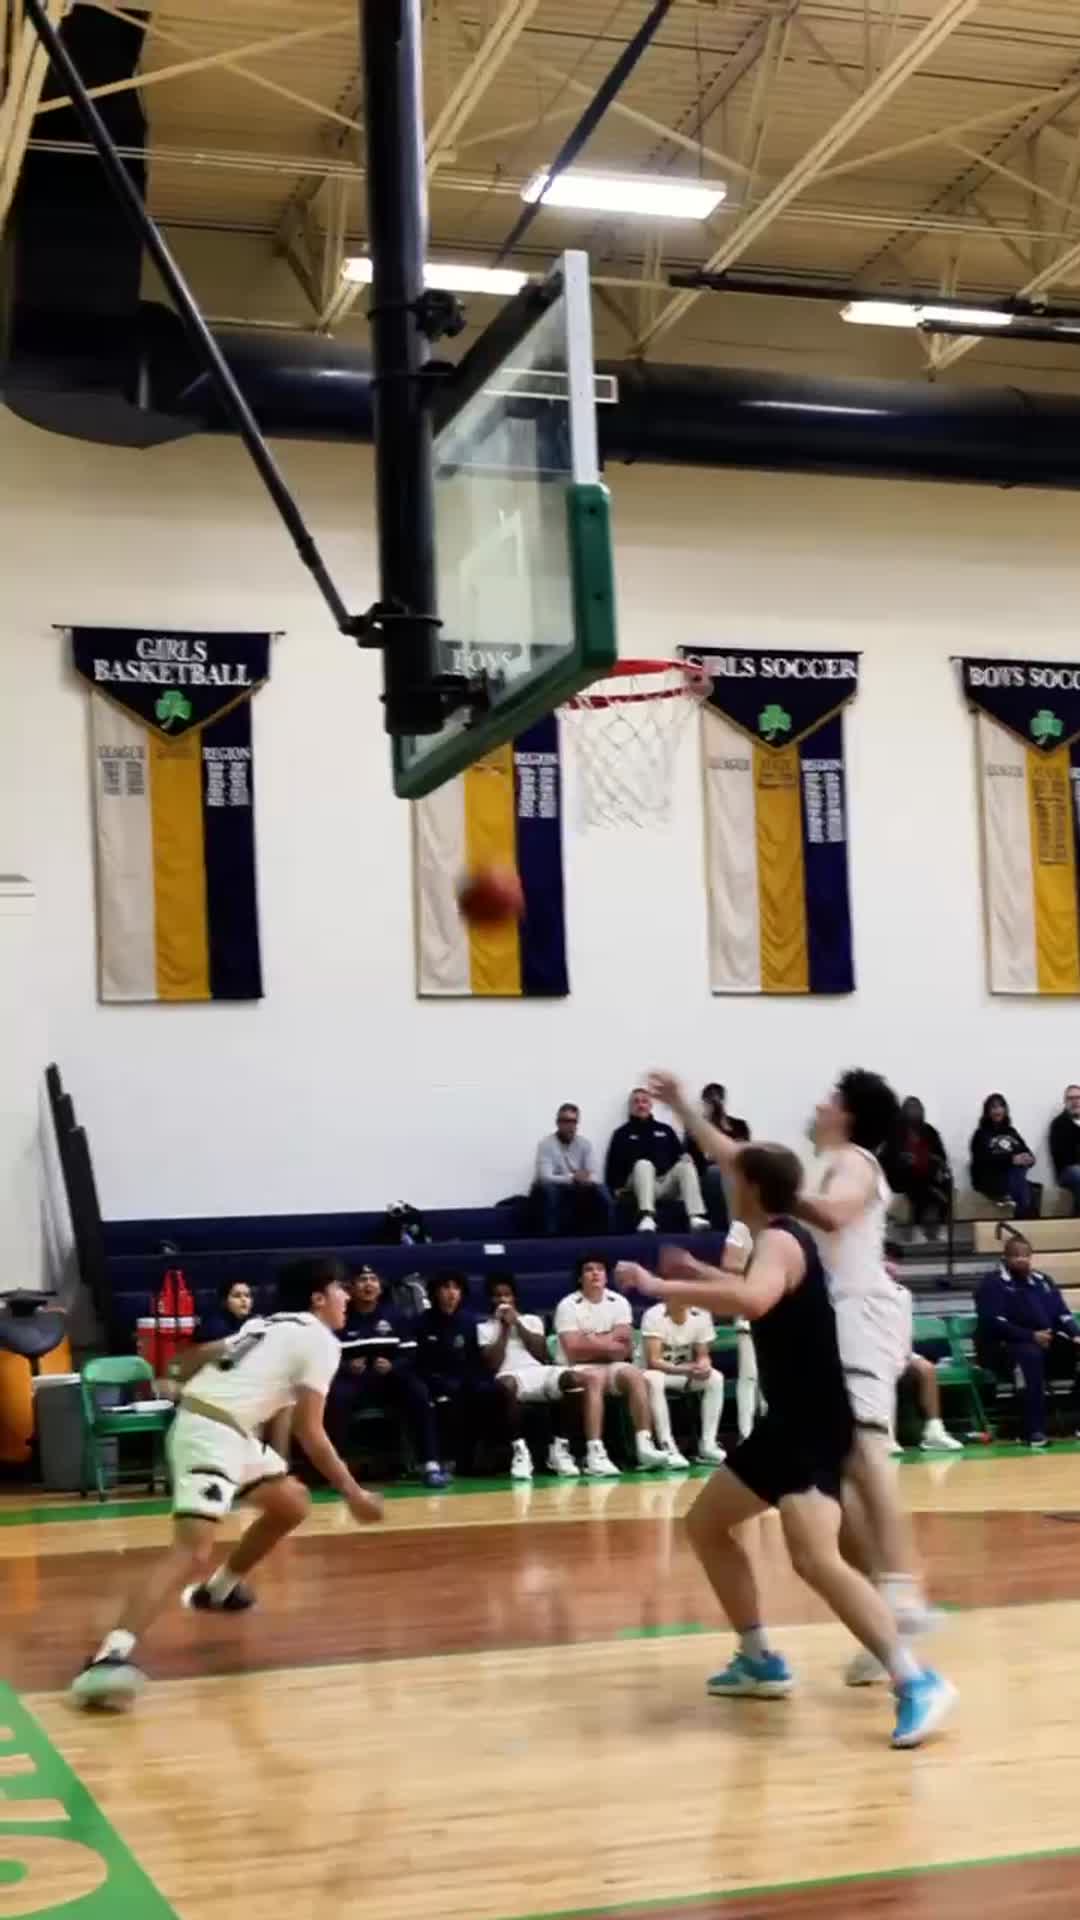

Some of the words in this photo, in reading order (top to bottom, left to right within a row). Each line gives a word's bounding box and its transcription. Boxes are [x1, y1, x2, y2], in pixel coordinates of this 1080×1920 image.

[136, 637, 208, 662] GIRLS
[93, 658, 252, 686] BASKETBALL
[760, 656, 858, 679] SOCCER
[970, 665, 1025, 687] BOYS
